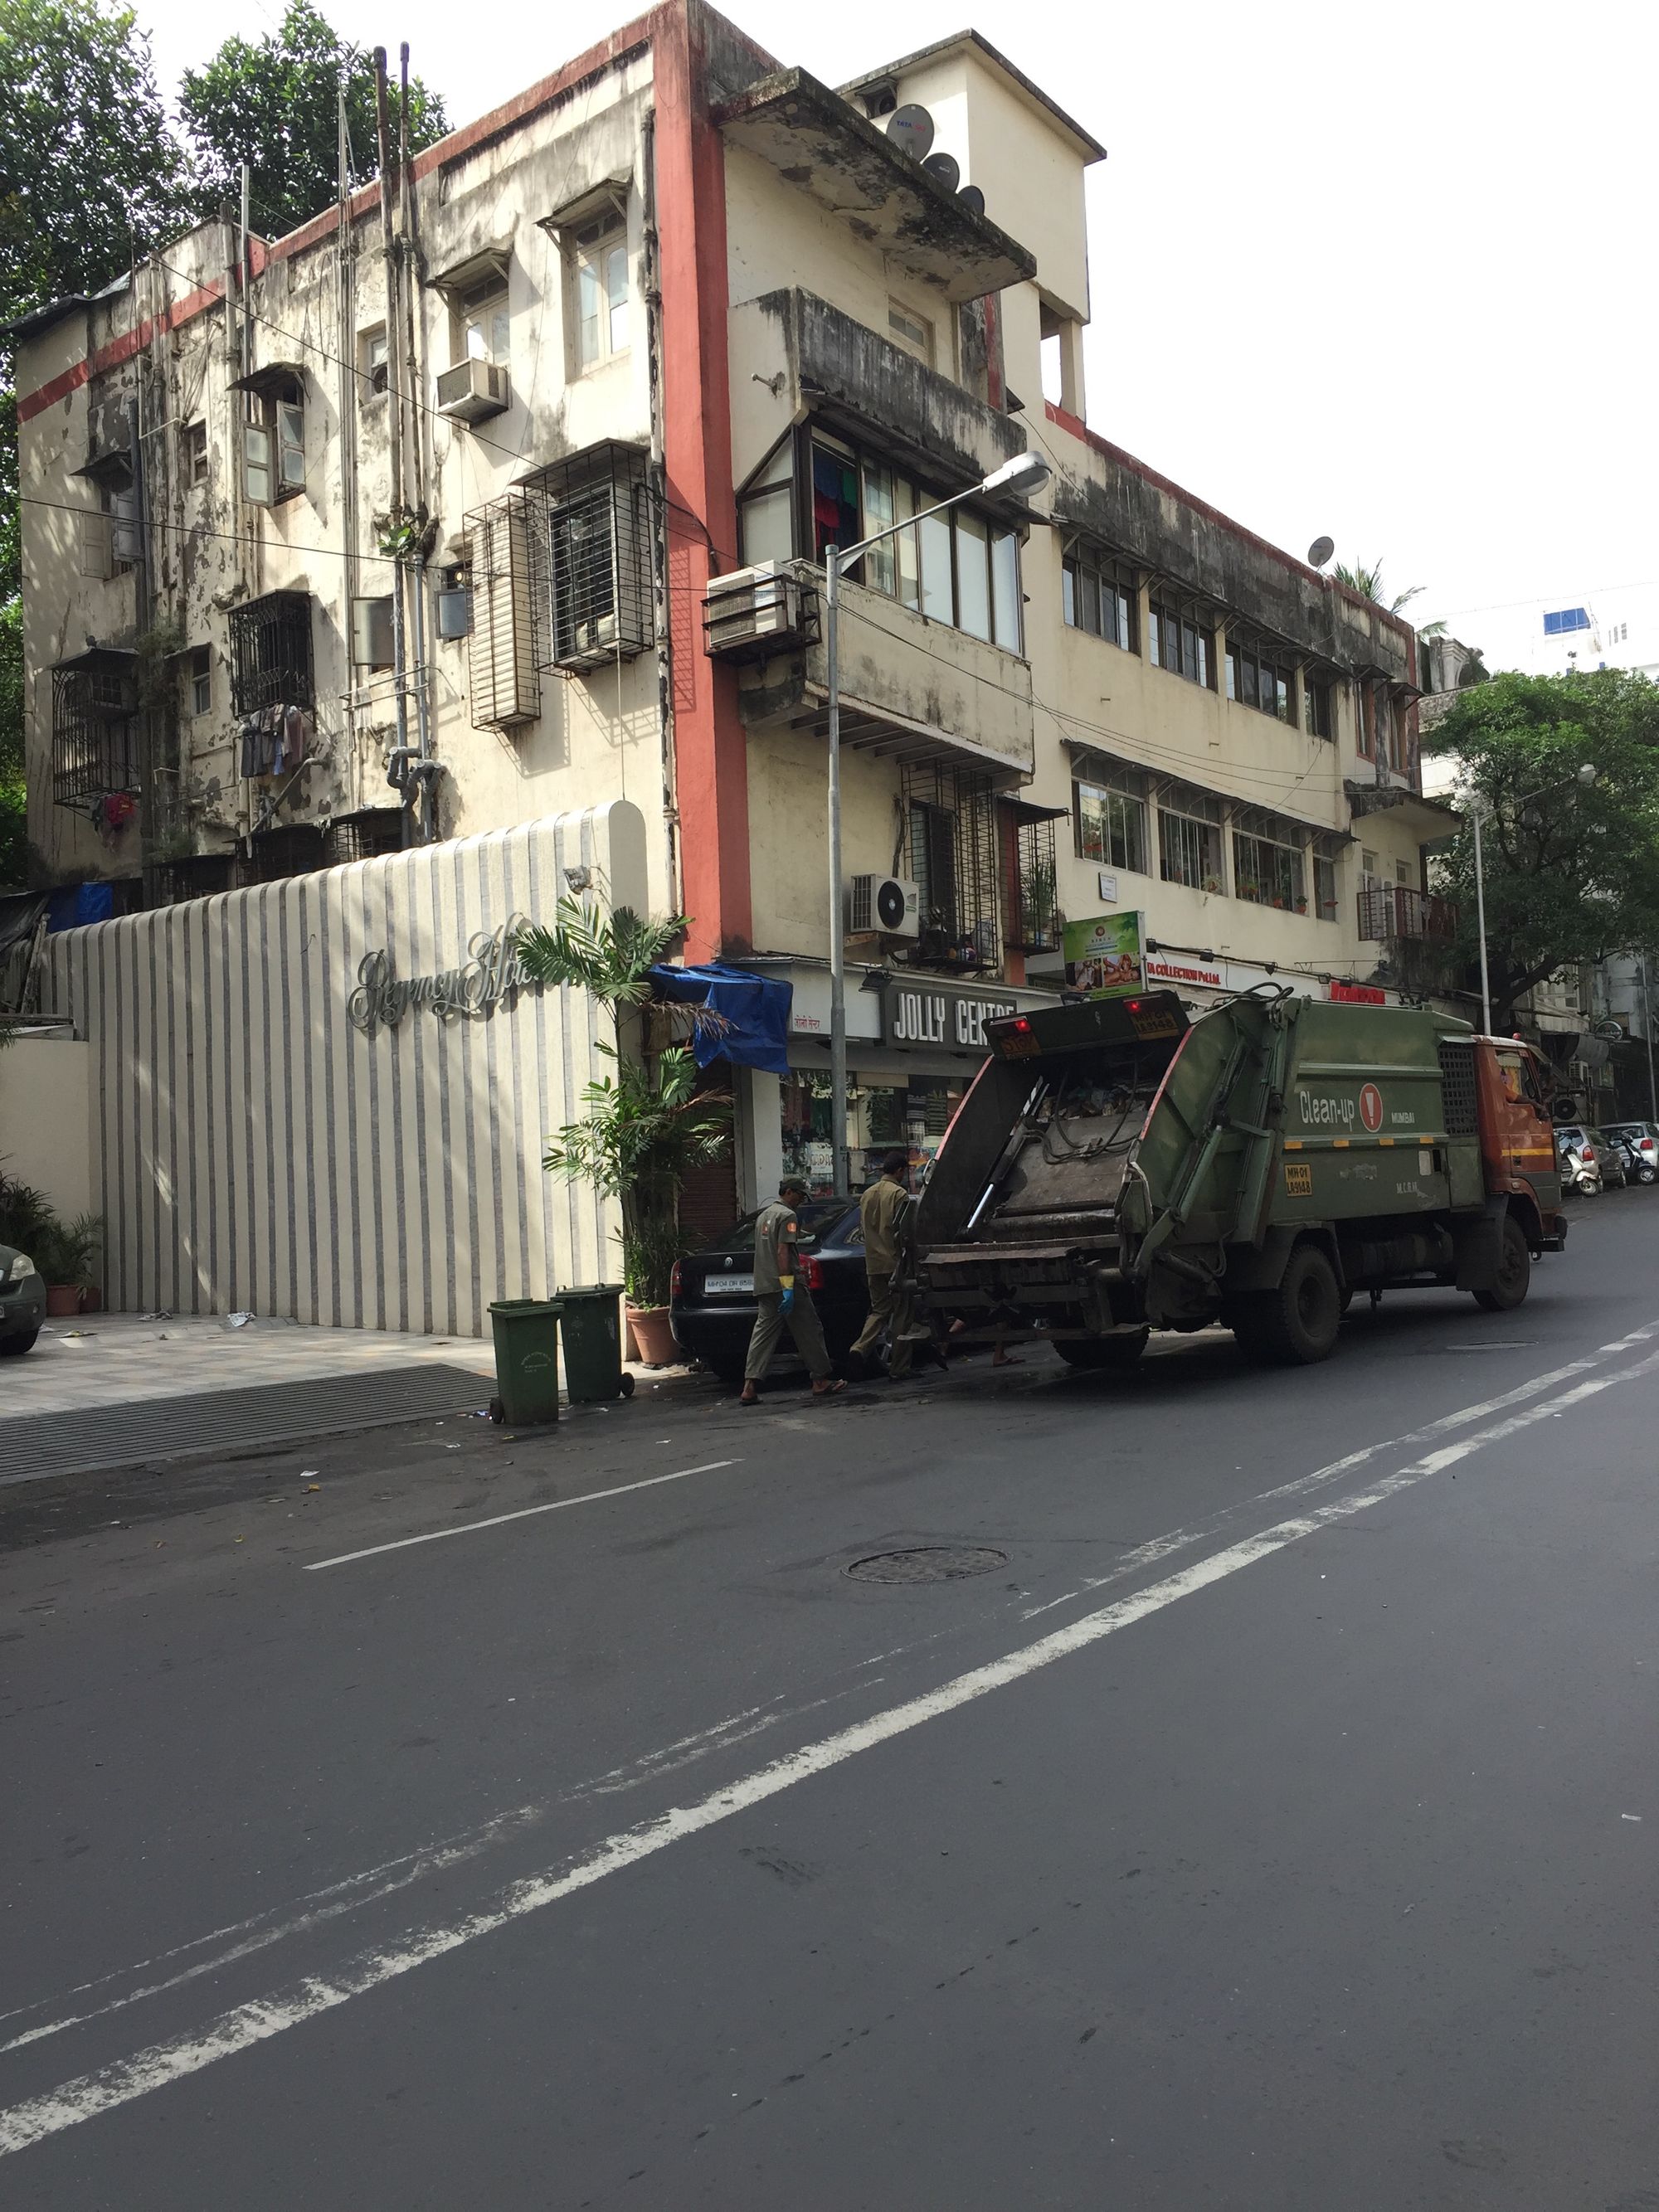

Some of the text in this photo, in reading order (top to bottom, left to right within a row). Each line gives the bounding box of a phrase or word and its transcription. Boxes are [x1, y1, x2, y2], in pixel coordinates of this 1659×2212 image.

[1155, 964, 1198, 981] COLLECTION
[893, 993, 1014, 1046] JOLLY CEN
[1300, 1091, 1355, 1132] Clean-up
[1391, 1112, 1415, 1124] MUMBAI
